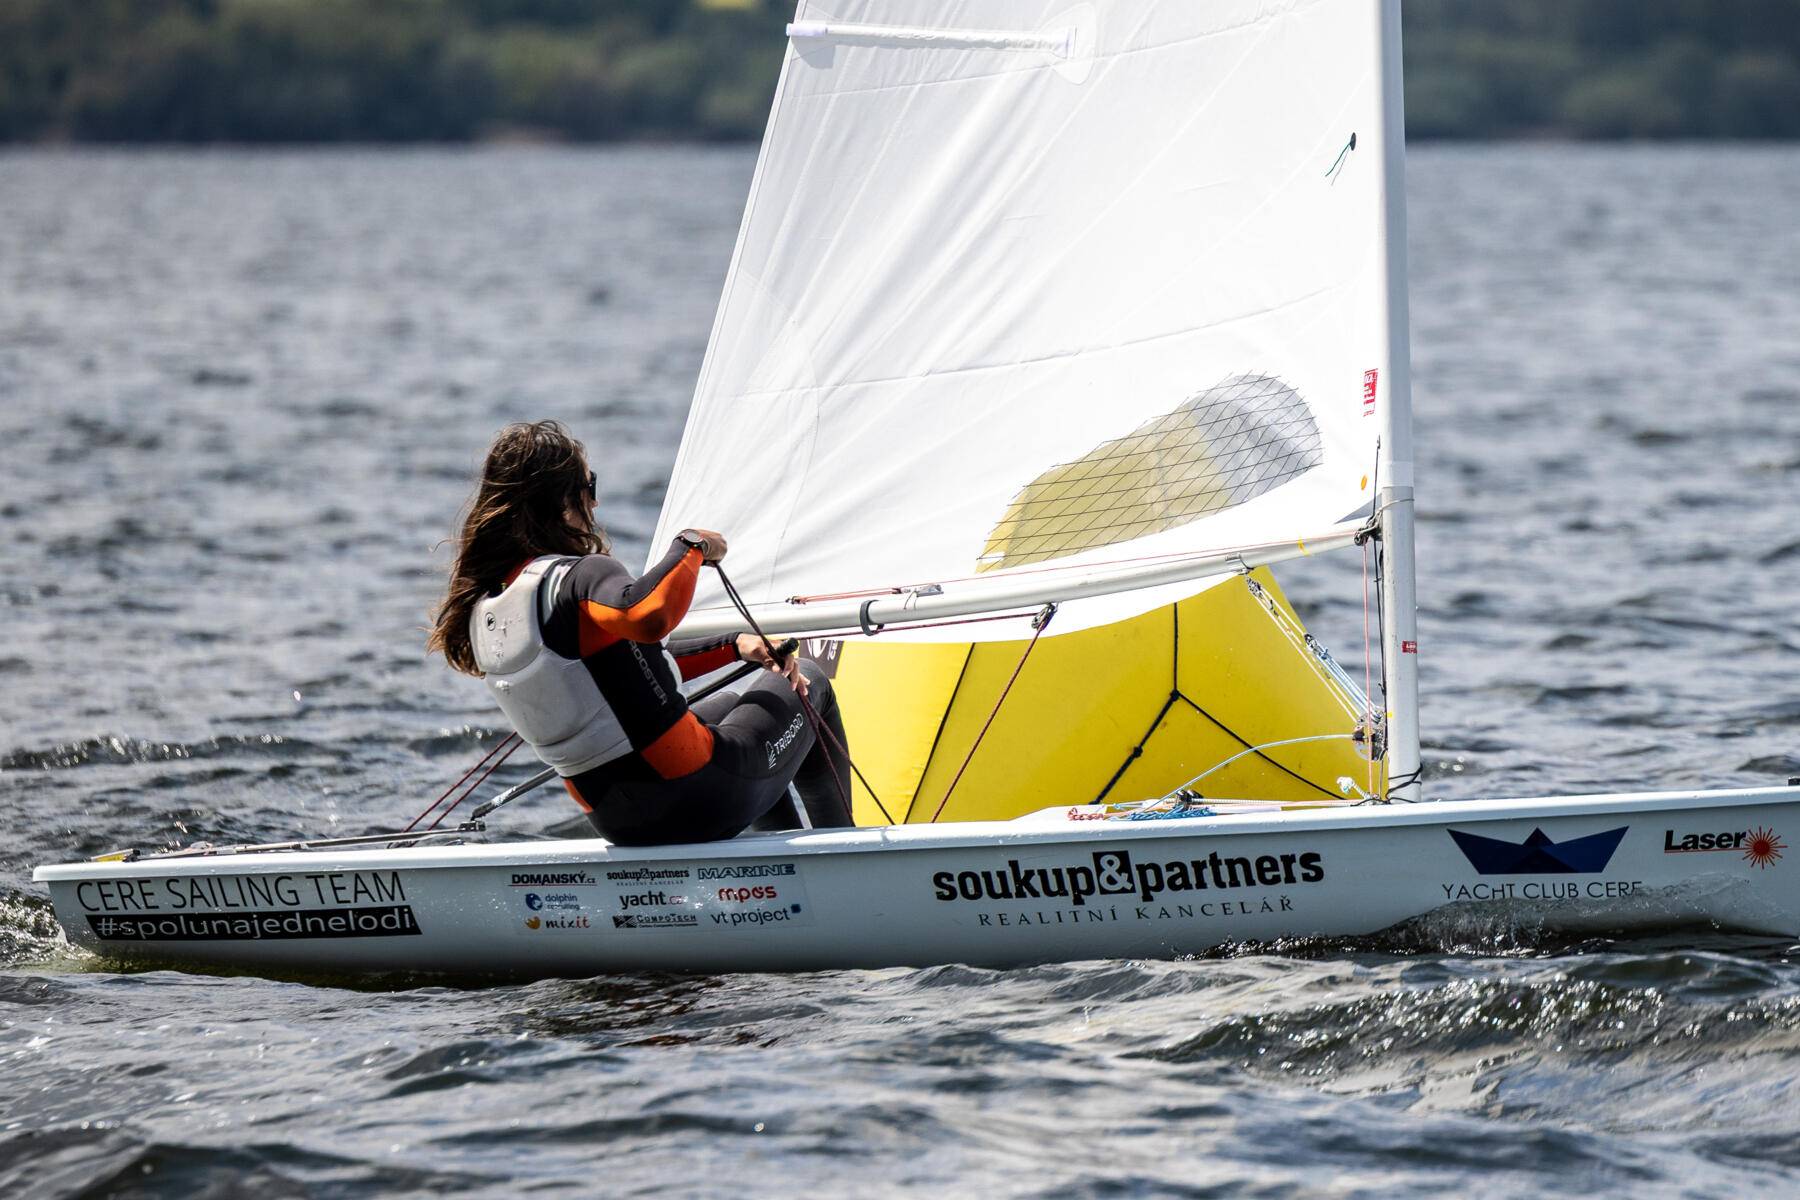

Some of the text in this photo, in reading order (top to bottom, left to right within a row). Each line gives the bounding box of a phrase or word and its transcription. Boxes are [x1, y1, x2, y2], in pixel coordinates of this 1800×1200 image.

[774, 713, 804, 755] TRIBORD
[1664, 829, 1748, 851] Laser
[698, 864, 796, 880] MARINE
[932, 850, 1325, 905] soukup&partners
[77, 871, 406, 912] CERE SAILING TEAM
[545, 893, 578, 904] dolphin
[1442, 882, 1517, 901] YACHT
[1523, 881, 1580, 900] CLUB
[710, 907, 791, 926] vt project
[977, 894, 1296, 927] REALITNÍ KANCELÁŘ
[97, 907, 412, 939] #spolunajednelodi
[546, 916, 590, 929] mixit
